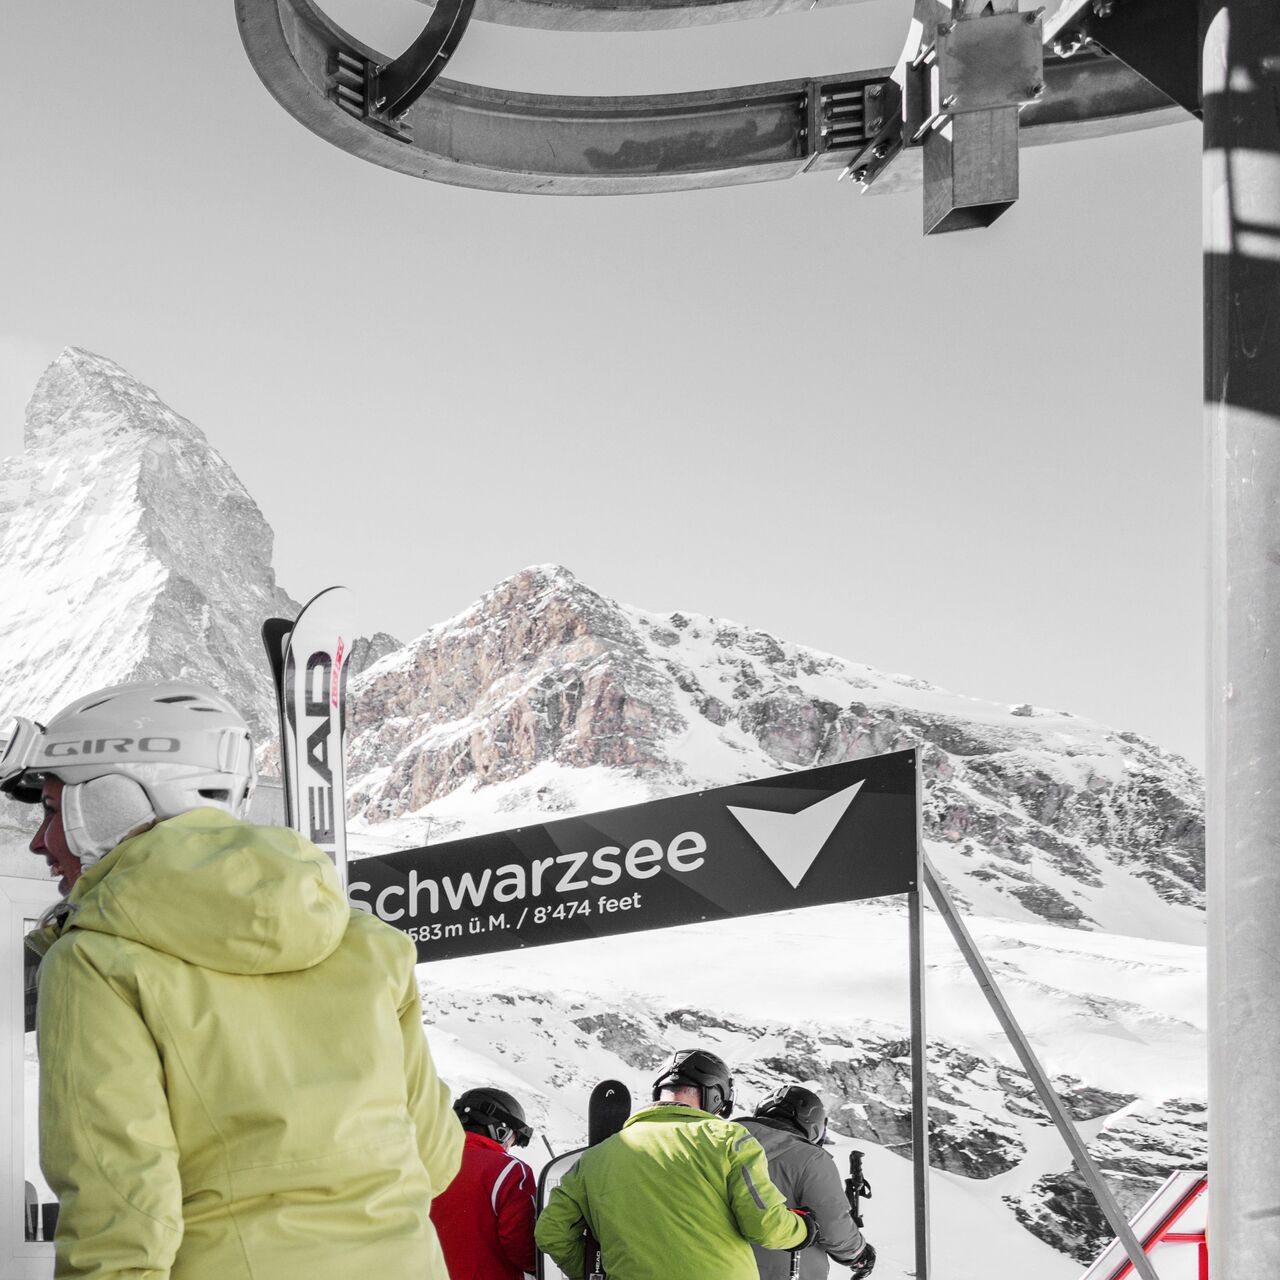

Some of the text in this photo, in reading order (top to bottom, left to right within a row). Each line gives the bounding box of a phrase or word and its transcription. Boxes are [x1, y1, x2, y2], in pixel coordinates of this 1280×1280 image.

[44, 737, 181, 758] GIRO
[306, 651, 337, 864] EAD
[349, 831, 707, 923] Schwarzsee
[597, 892, 642, 914] feet
